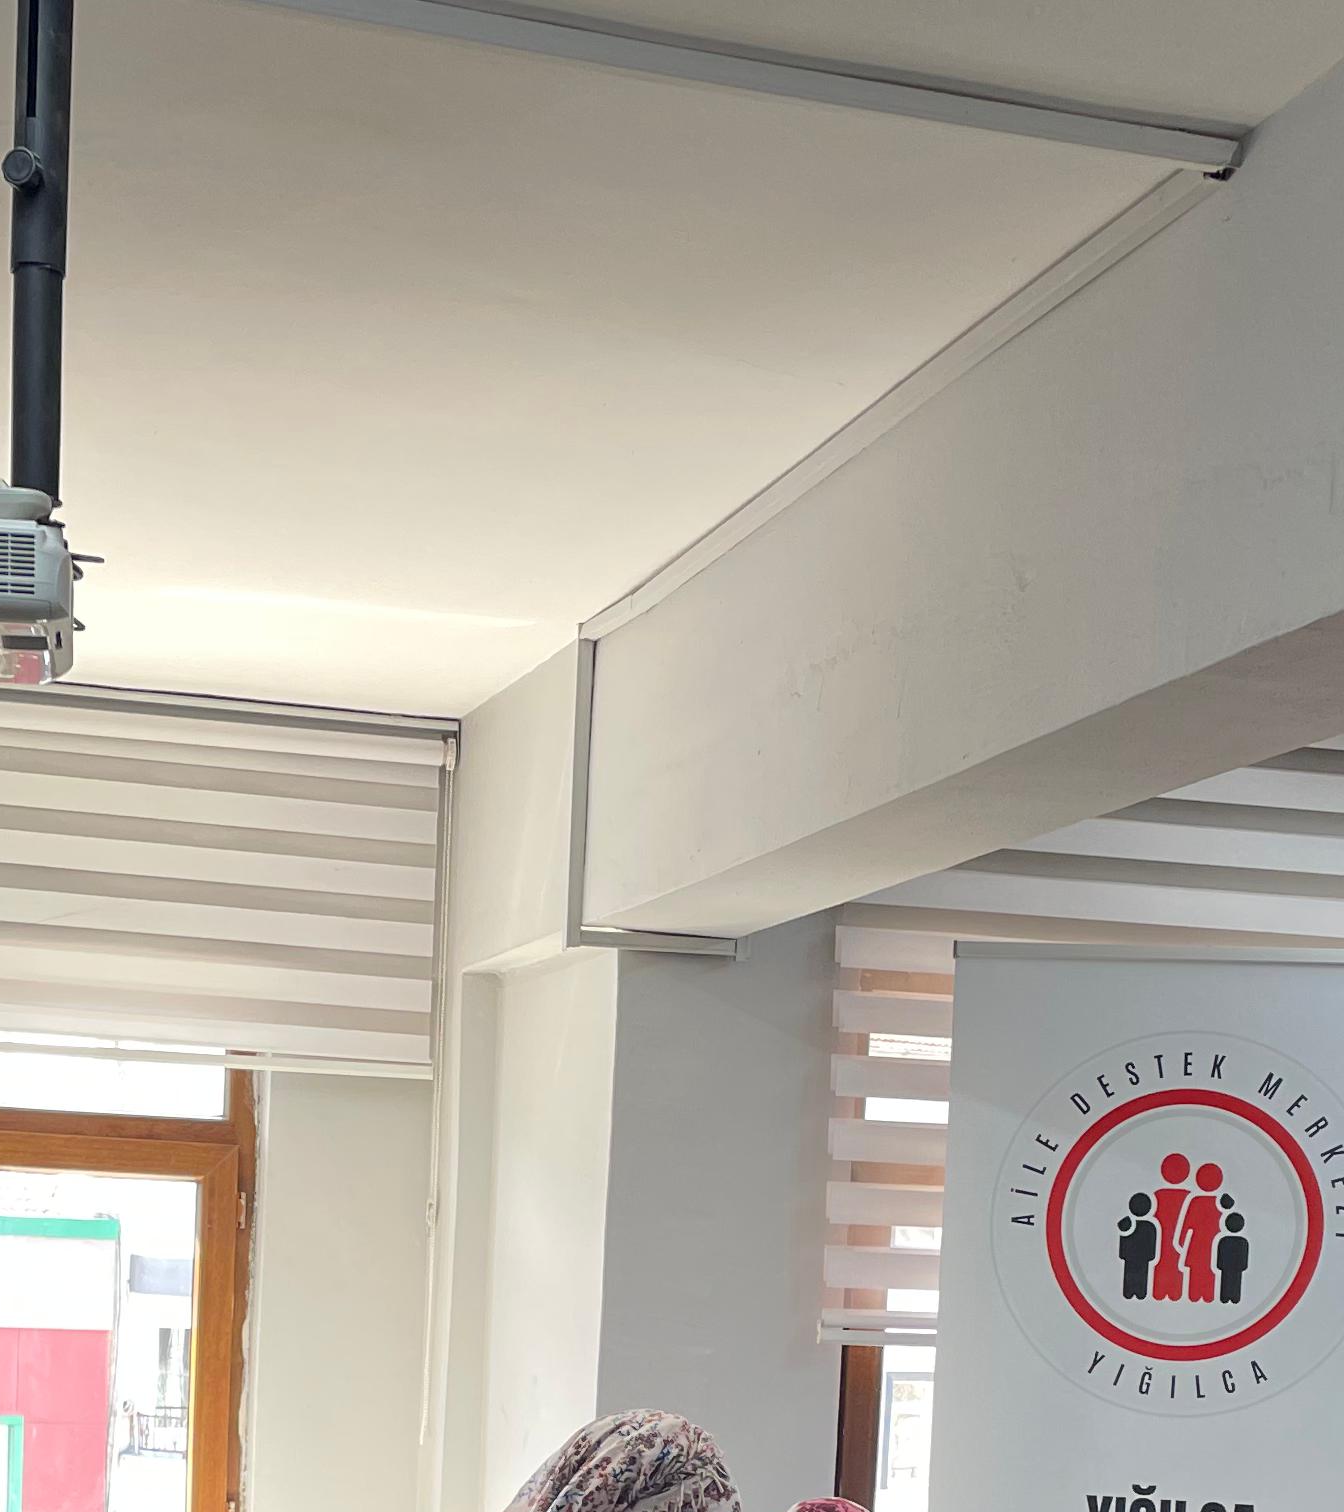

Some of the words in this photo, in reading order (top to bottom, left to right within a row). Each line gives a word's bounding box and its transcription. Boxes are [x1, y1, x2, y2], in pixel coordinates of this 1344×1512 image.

[1010, 1132, 1060, 1227] AİLE
[1069, 1051, 1227, 1116] DESTEK
[1086, 1350, 1269, 1400] YIĞILCA
